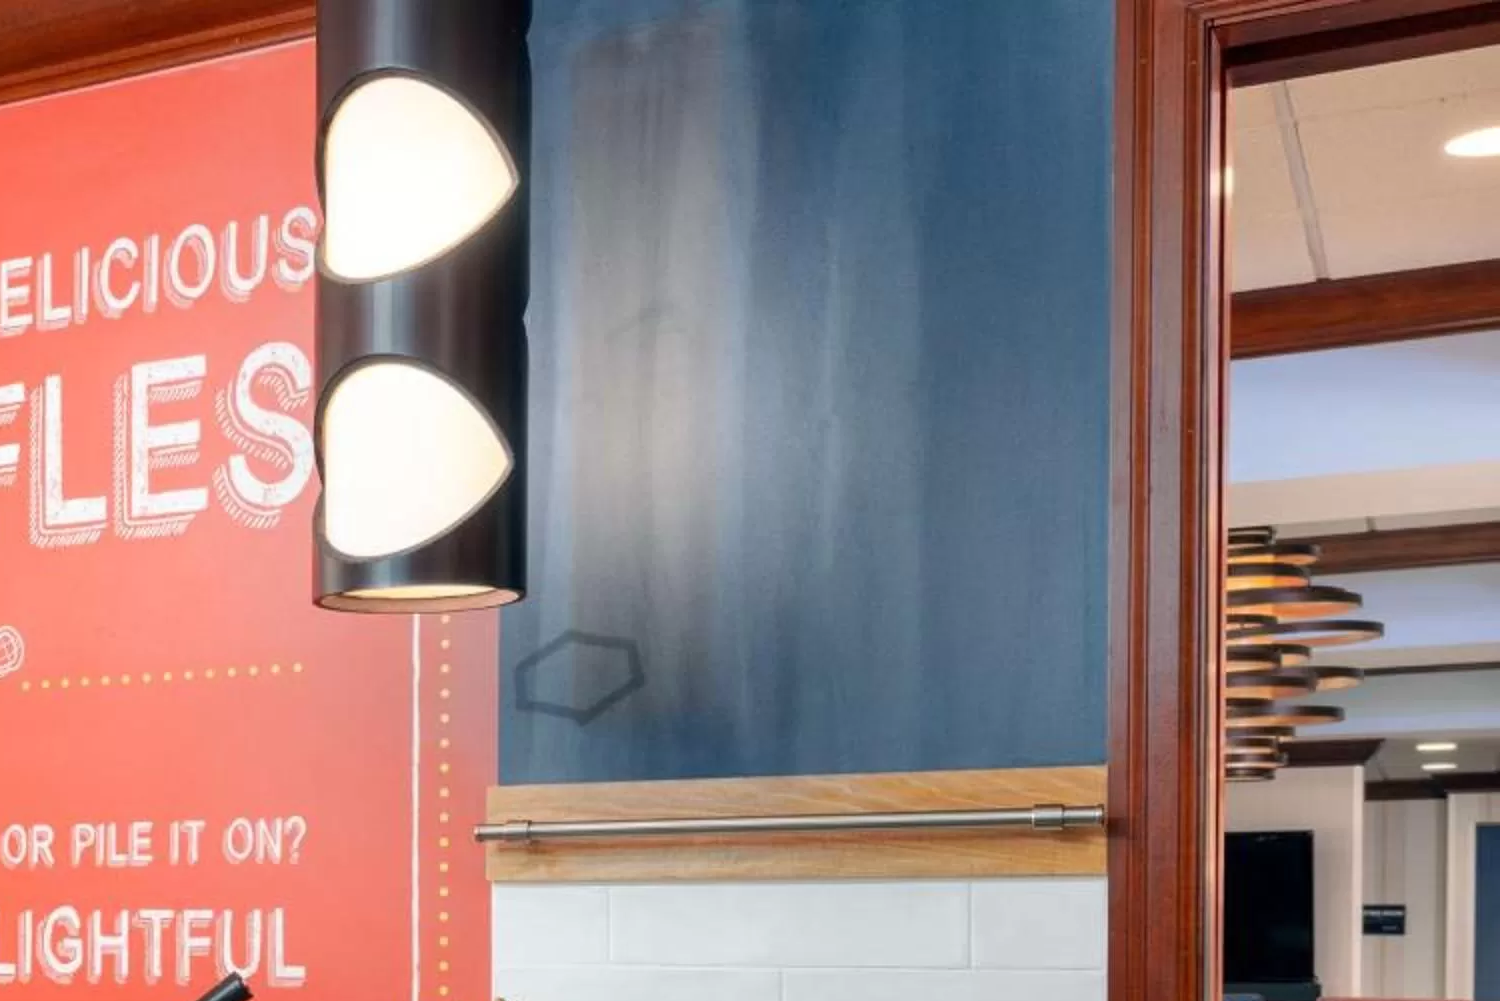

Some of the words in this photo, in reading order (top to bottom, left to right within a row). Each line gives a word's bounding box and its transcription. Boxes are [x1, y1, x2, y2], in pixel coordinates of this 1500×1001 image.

[1, 824, 54, 870] OR
[71, 821, 153, 868] PILE
[169, 820, 205, 867] IT
[222, 816, 306, 865] ON?
